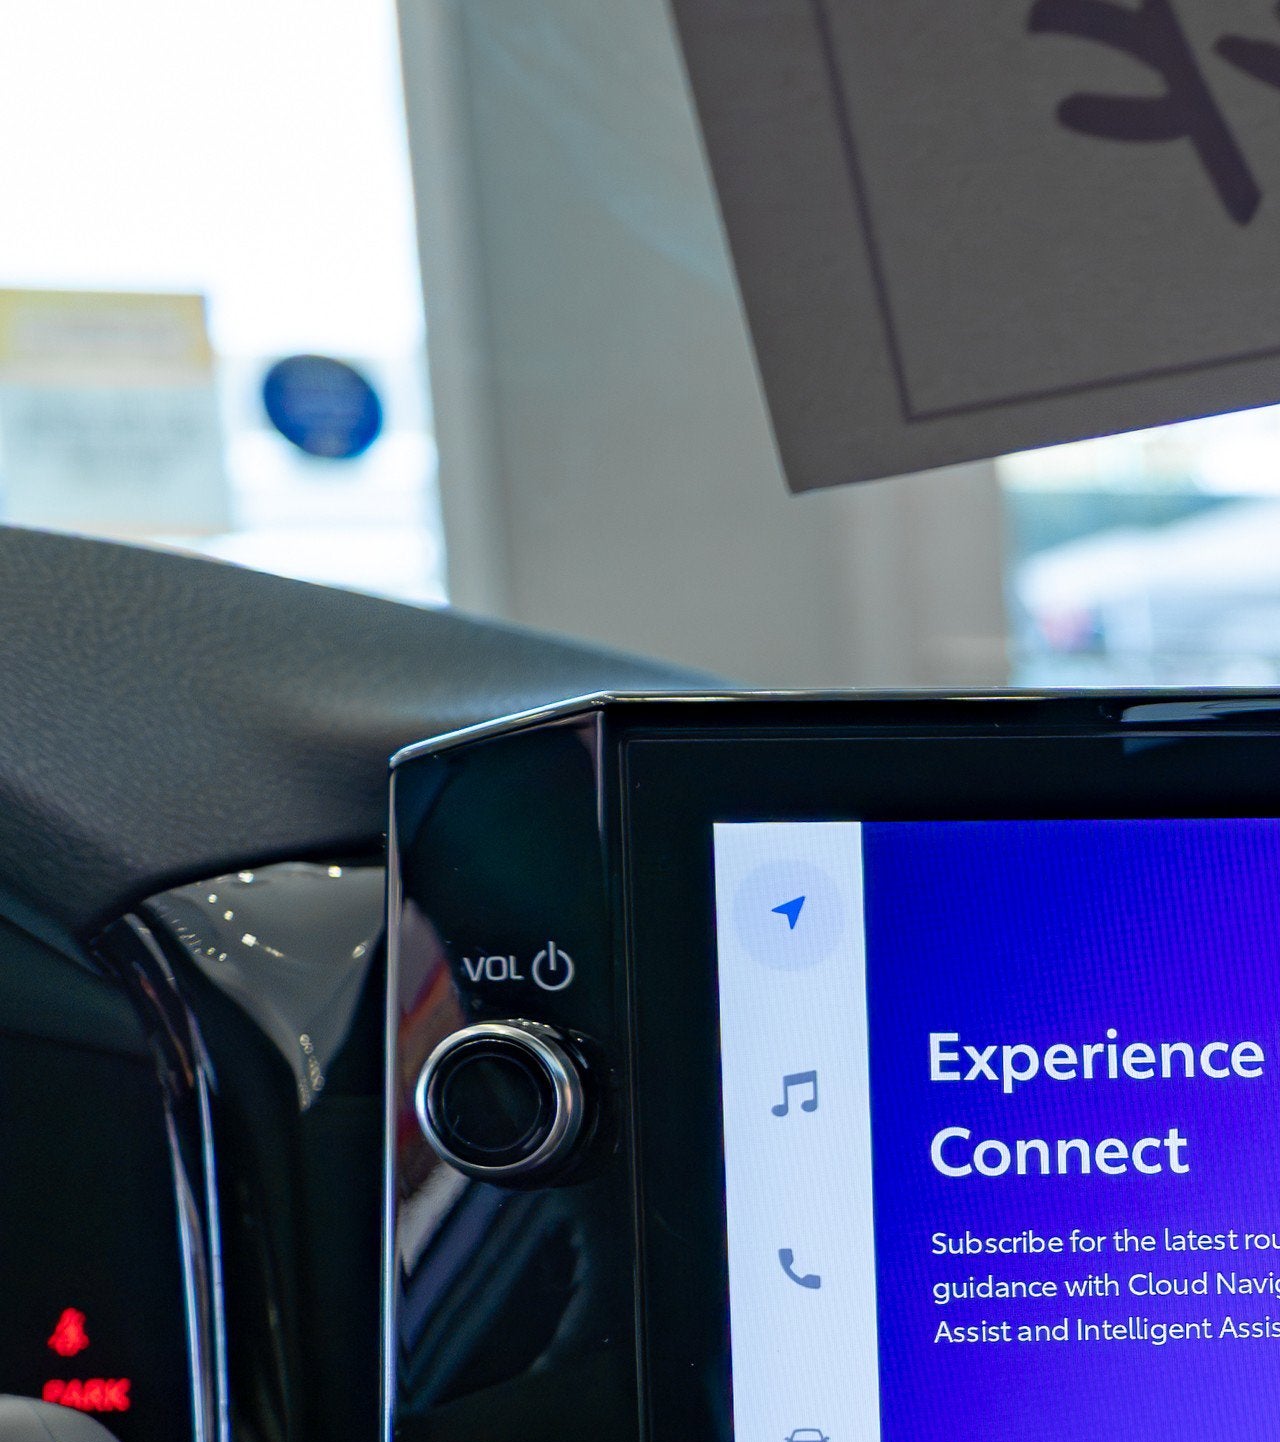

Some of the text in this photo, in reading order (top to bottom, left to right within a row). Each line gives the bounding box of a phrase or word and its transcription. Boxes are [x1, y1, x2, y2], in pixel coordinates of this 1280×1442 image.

[463, 955, 525, 982] VOL
[928, 1028, 1265, 1093] Experience
[930, 1126, 1190, 1178] Connect
[931, 1228, 1064, 1256] Subscribe
[1069, 1227, 1108, 1254] for
[1113, 1227, 1157, 1253] the
[1163, 1226, 1239, 1252] latest
[933, 1273, 1057, 1305] guidance
[1065, 1273, 1120, 1298] with
[1128, 1271, 1208, 1297] Cloud
[934, 1317, 1011, 1343] Assist
[1017, 1317, 1069, 1342] and
[1076, 1315, 1212, 1348] Intelligent
